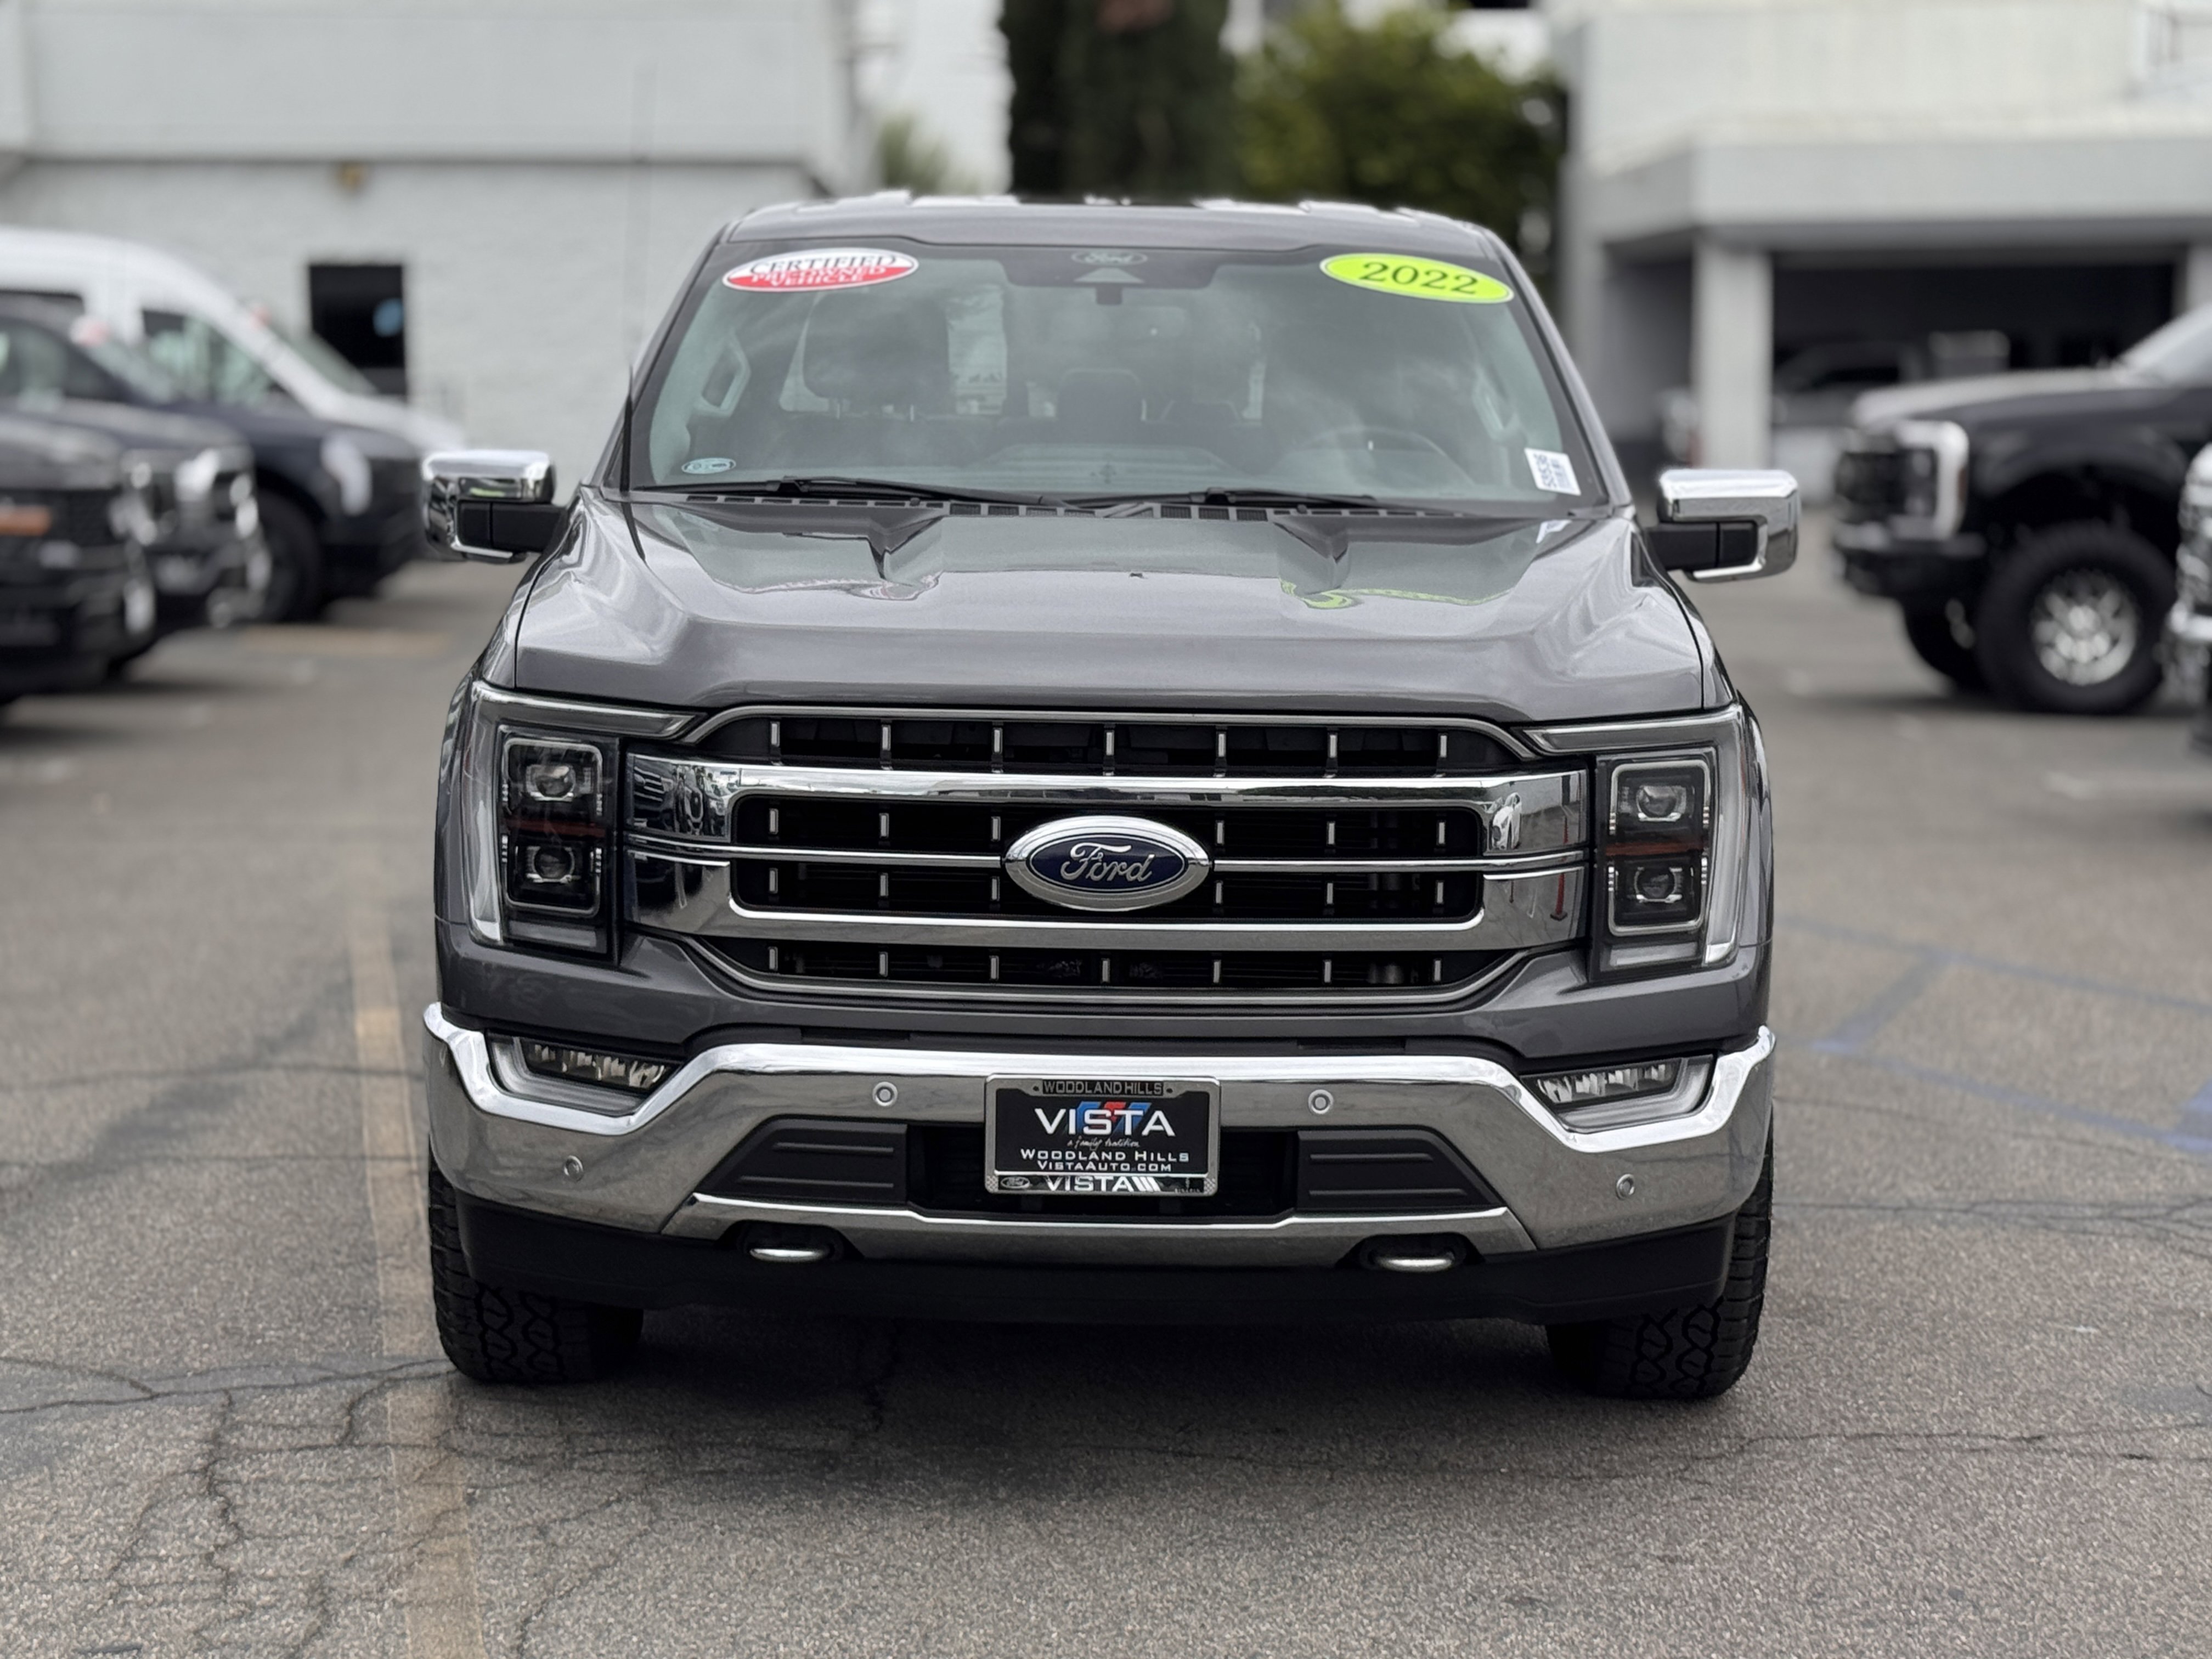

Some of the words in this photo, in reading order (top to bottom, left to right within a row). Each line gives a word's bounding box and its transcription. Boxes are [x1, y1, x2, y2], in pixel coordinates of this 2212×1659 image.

[750, 255, 896, 274] CERTIFIED
[771, 270, 864, 286] VEHICLE
[1358, 262, 1478, 294] 2022
[1060, 842, 1155, 882] Ford
[1044, 1081, 1122, 1094] WOODLAND
[1124, 1082, 1163, 1094] HILLS
[1034, 1108, 1176, 1136] VISTA
[1105, 1137, 1140, 1147] tradition
[1020, 1149, 1126, 1161] WOODLAND
[1135, 1150, 1189, 1163] HILLS
[1043, 1175, 1135, 1192] VISTA
